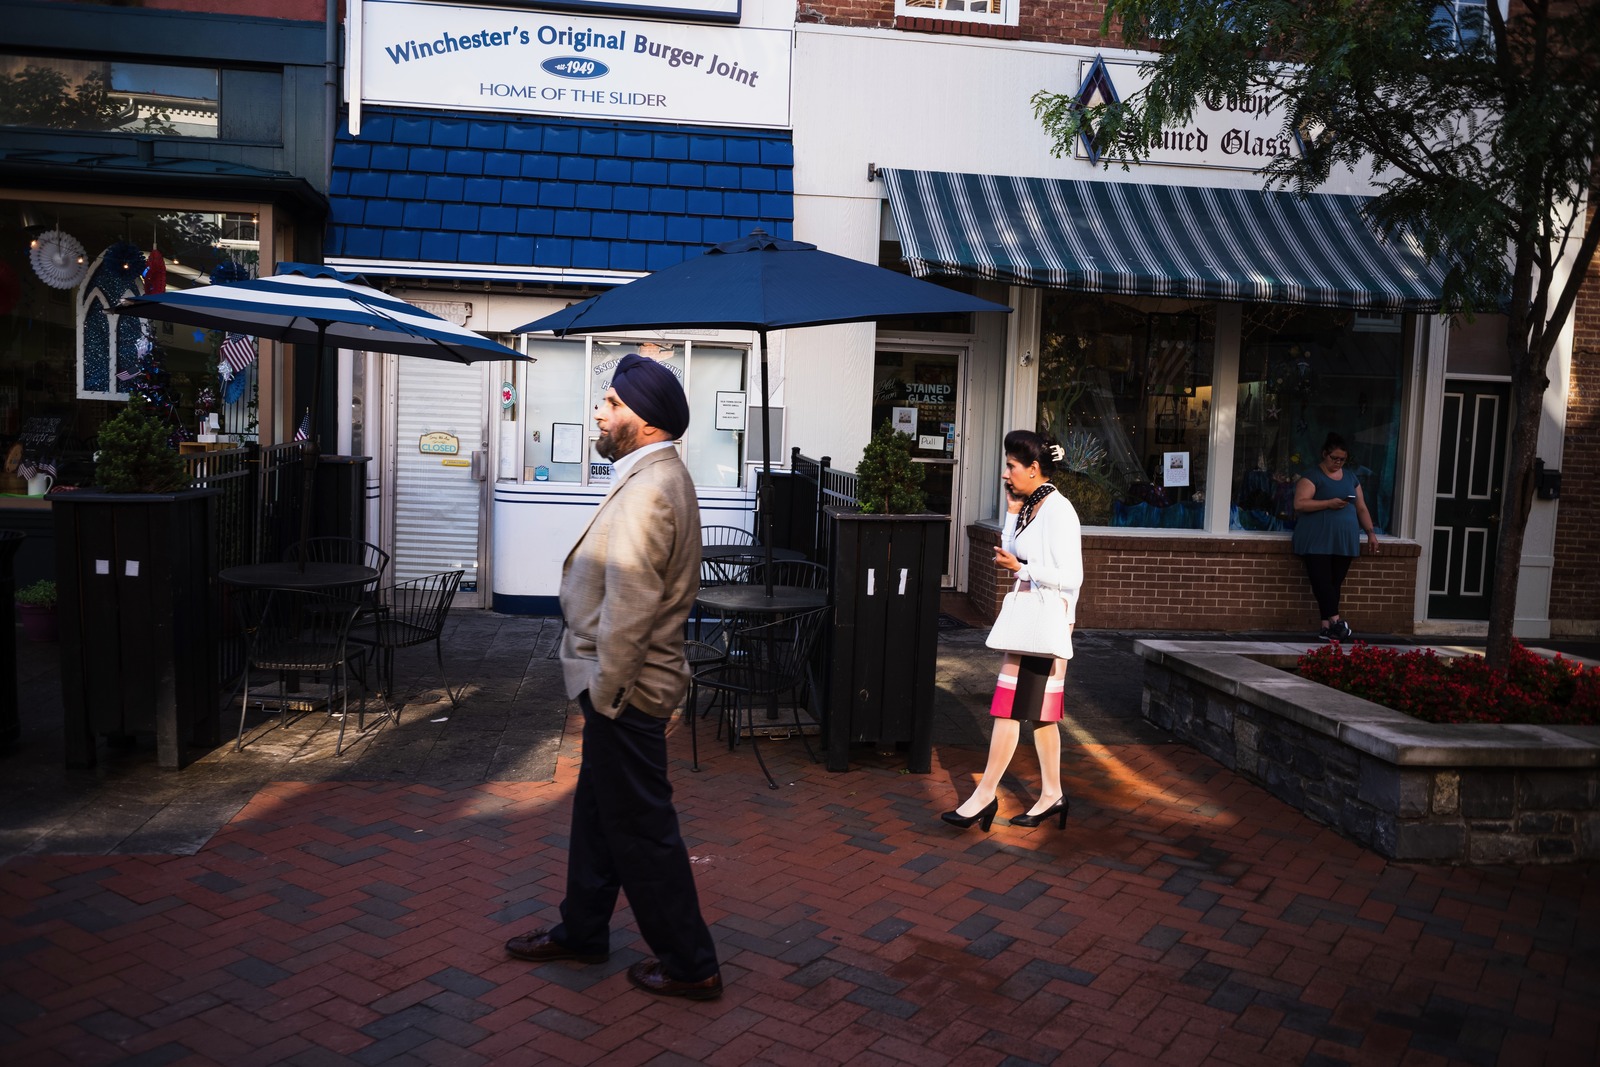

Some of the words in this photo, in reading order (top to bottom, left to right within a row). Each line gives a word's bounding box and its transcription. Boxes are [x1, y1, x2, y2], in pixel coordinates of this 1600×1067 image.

[385, 26, 530, 65] Winchester's
[537, 25, 627, 53] Original
[633, 34, 705, 68] Burger
[706, 54, 760, 88] Joint
[480, 83, 537, 98] HOME
[541, 87, 567, 101] OF
[571, 89, 605, 104] THE
[610, 91, 667, 107] SLIDER
[1220, 128, 1291, 157] Glass
[906, 383, 951, 395] STAINED
[908, 394, 945, 404] GLASS
[921, 437, 936, 446] Pull
[421, 443, 457, 453] CLOSED
